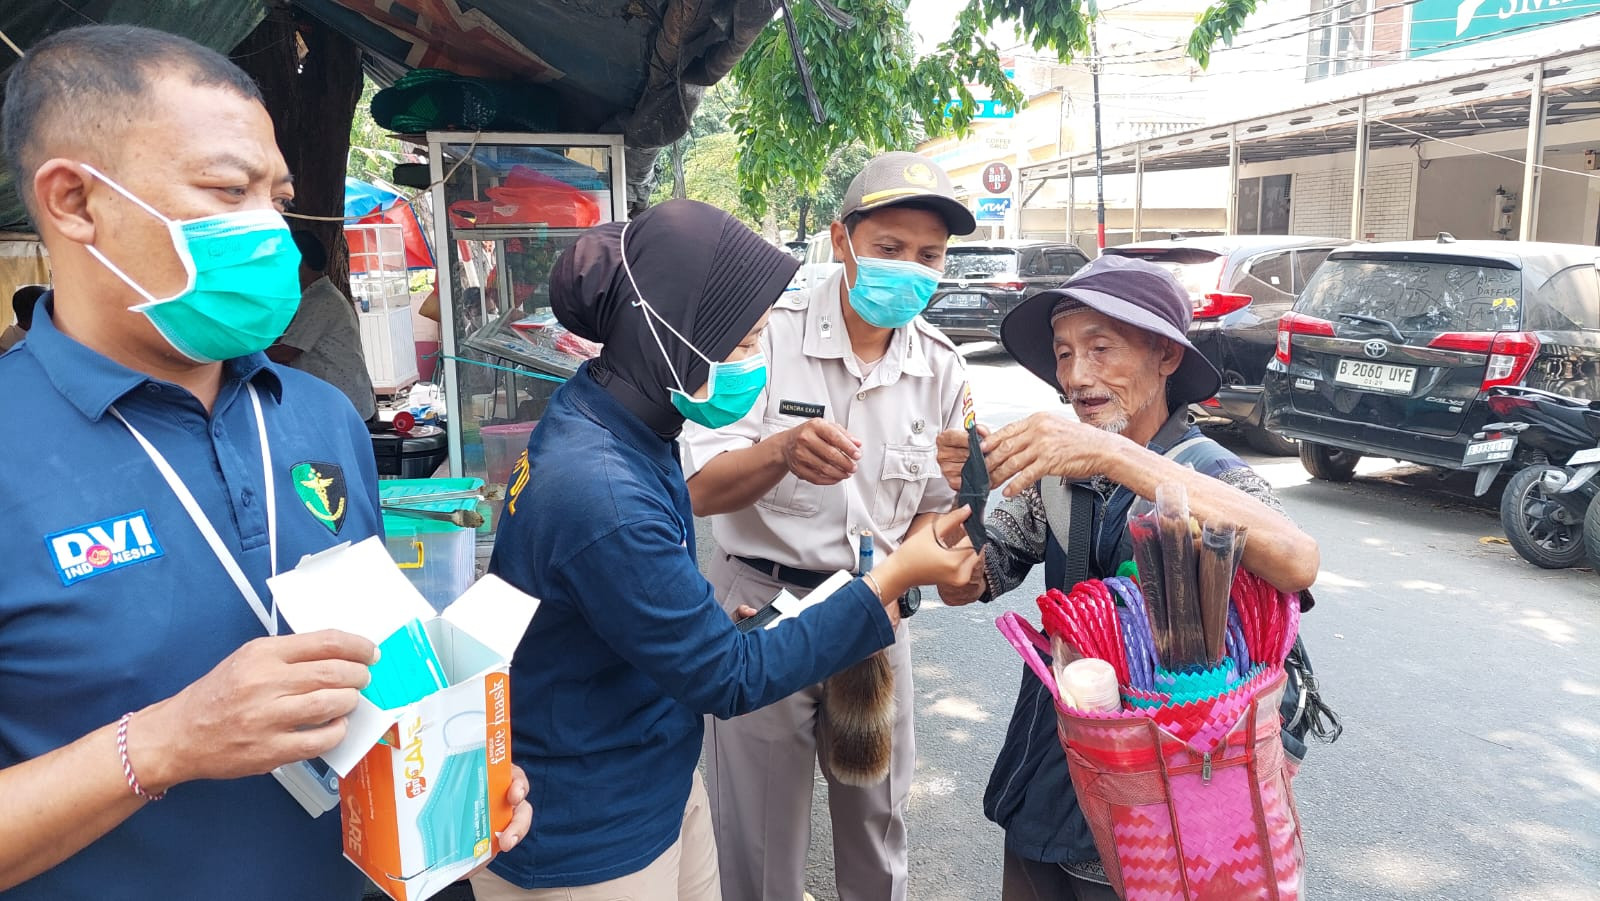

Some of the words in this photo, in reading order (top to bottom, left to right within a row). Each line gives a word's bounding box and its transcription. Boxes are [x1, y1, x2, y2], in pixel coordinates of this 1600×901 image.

[1339, 361, 1348, 375] B
[1352, 363, 1383, 380] 2060
[1388, 367, 1413, 383] UYE
[782, 403, 804, 412] HENDRA
[52, 515, 153, 570] DVI
[488, 678, 506, 726] mask
[490, 728, 506, 765] face
[347, 795, 362, 857] CARE
